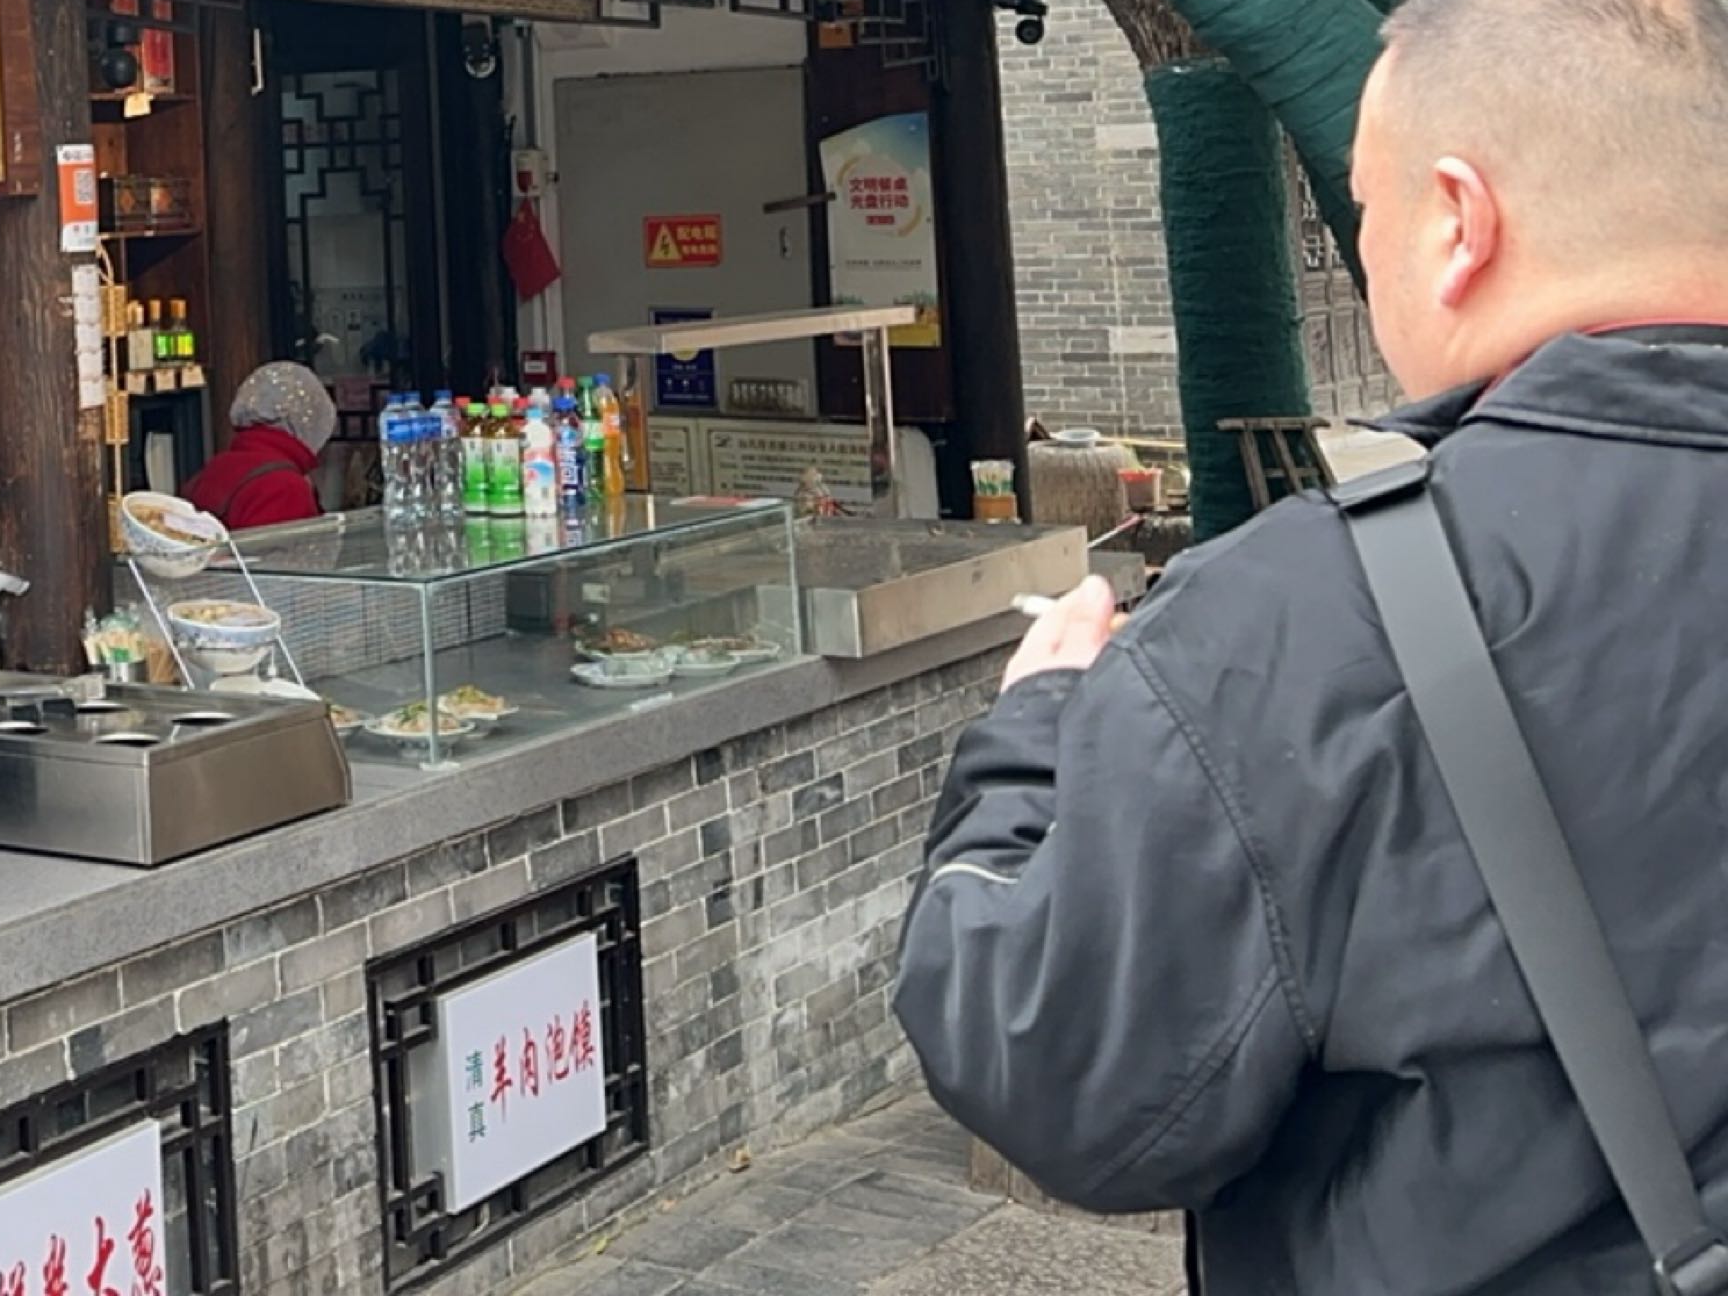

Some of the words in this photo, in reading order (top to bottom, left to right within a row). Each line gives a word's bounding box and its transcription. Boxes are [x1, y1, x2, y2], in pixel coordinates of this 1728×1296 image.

[466, 1050, 486, 1144] 清真
[491, 999, 595, 1123] 羊肉泡馍
